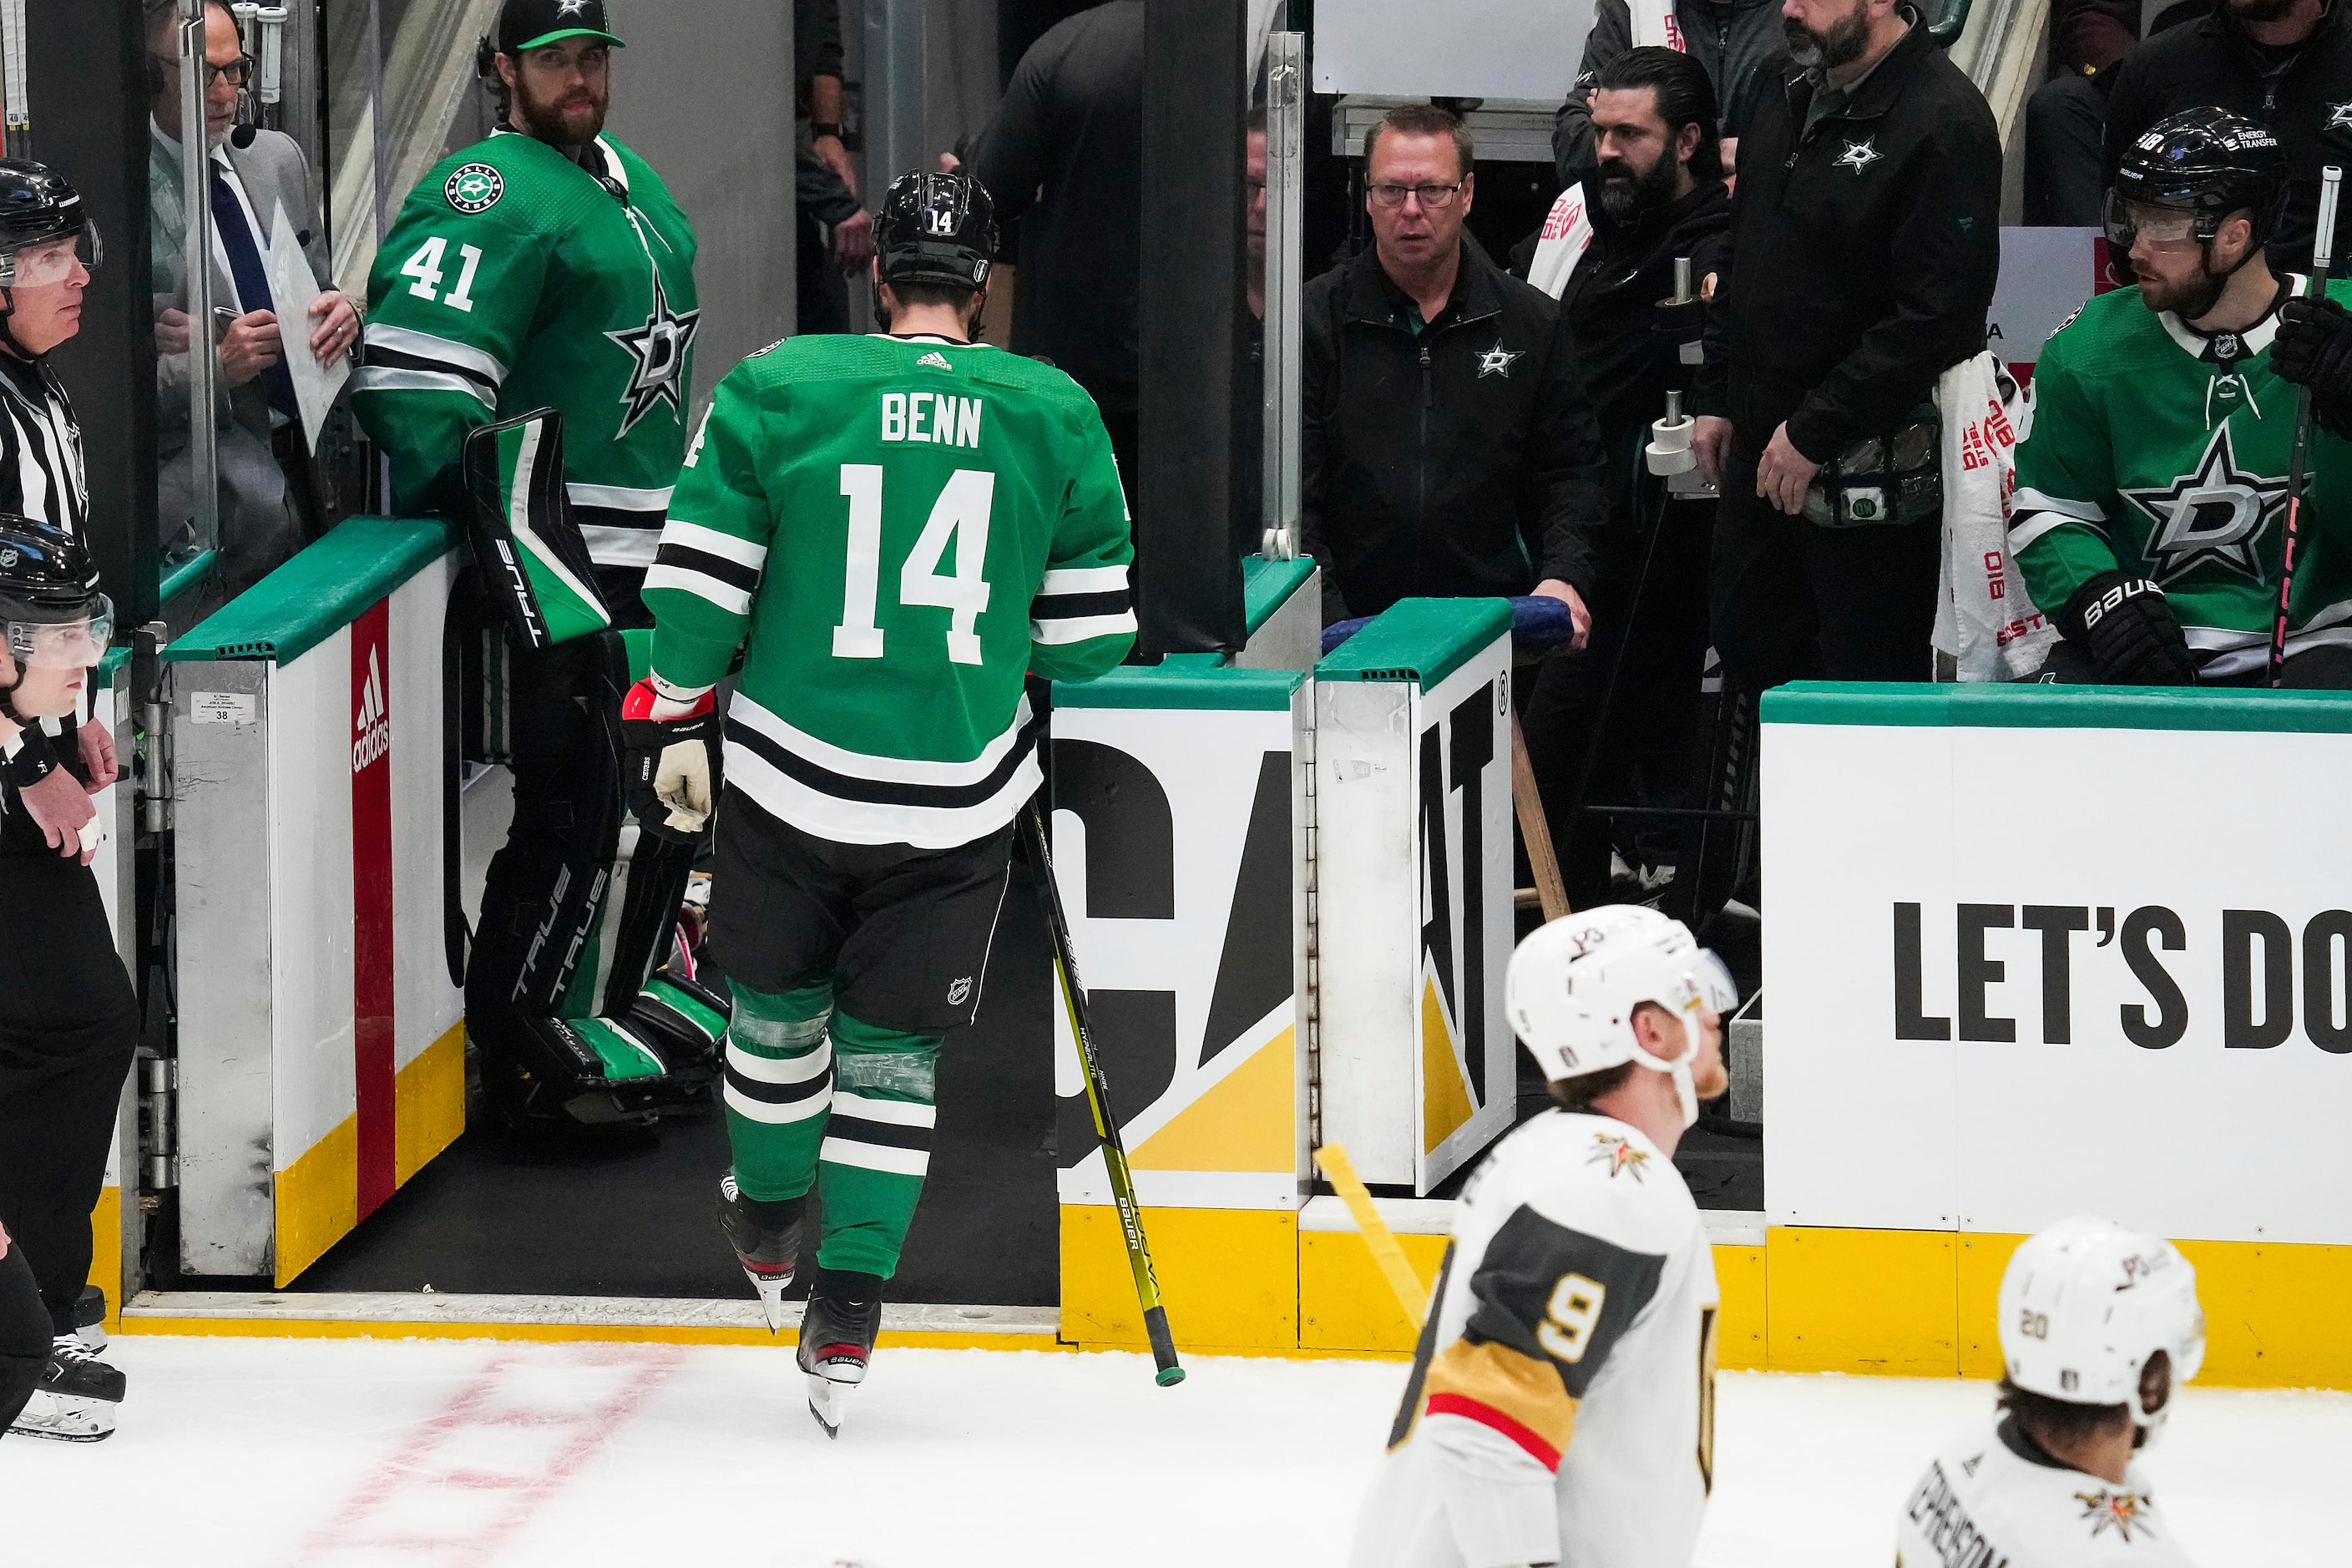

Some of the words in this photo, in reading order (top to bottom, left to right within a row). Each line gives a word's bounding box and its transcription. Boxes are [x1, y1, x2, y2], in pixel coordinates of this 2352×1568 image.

[2238, 130, 2267, 140] ENERGY
[2240, 138, 2278, 149] TRANSFER
[448, 188, 491, 210] STARS
[453, 166, 501, 190] DALLAS
[931, 210, 952, 233] 14
[400, 236, 483, 312] 41
[917, 358, 953, 370] adidas
[882, 392, 982, 448] BENN
[832, 464, 994, 665] 14
[495, 539, 542, 648] TRUE
[216, 711, 228, 720] 38
[672, 722, 705, 732] BAUER
[352, 718, 389, 773] adidas
[641, 756, 650, 781] CHUBBS
[512, 863, 571, 1003] TRUE
[549, 868, 608, 1004] TRUE
[1893, 902, 2189, 1050] LET'S
[2223, 908, 2352, 1054] DO
[1079, 1027, 1097, 1079] HYPERLITE
[1119, 1196, 1139, 1250] BAUER
[1536, 1272, 1606, 1364] 9
[2021, 1308, 2049, 1341] 20
[831, 1356, 865, 1367] BAUER
